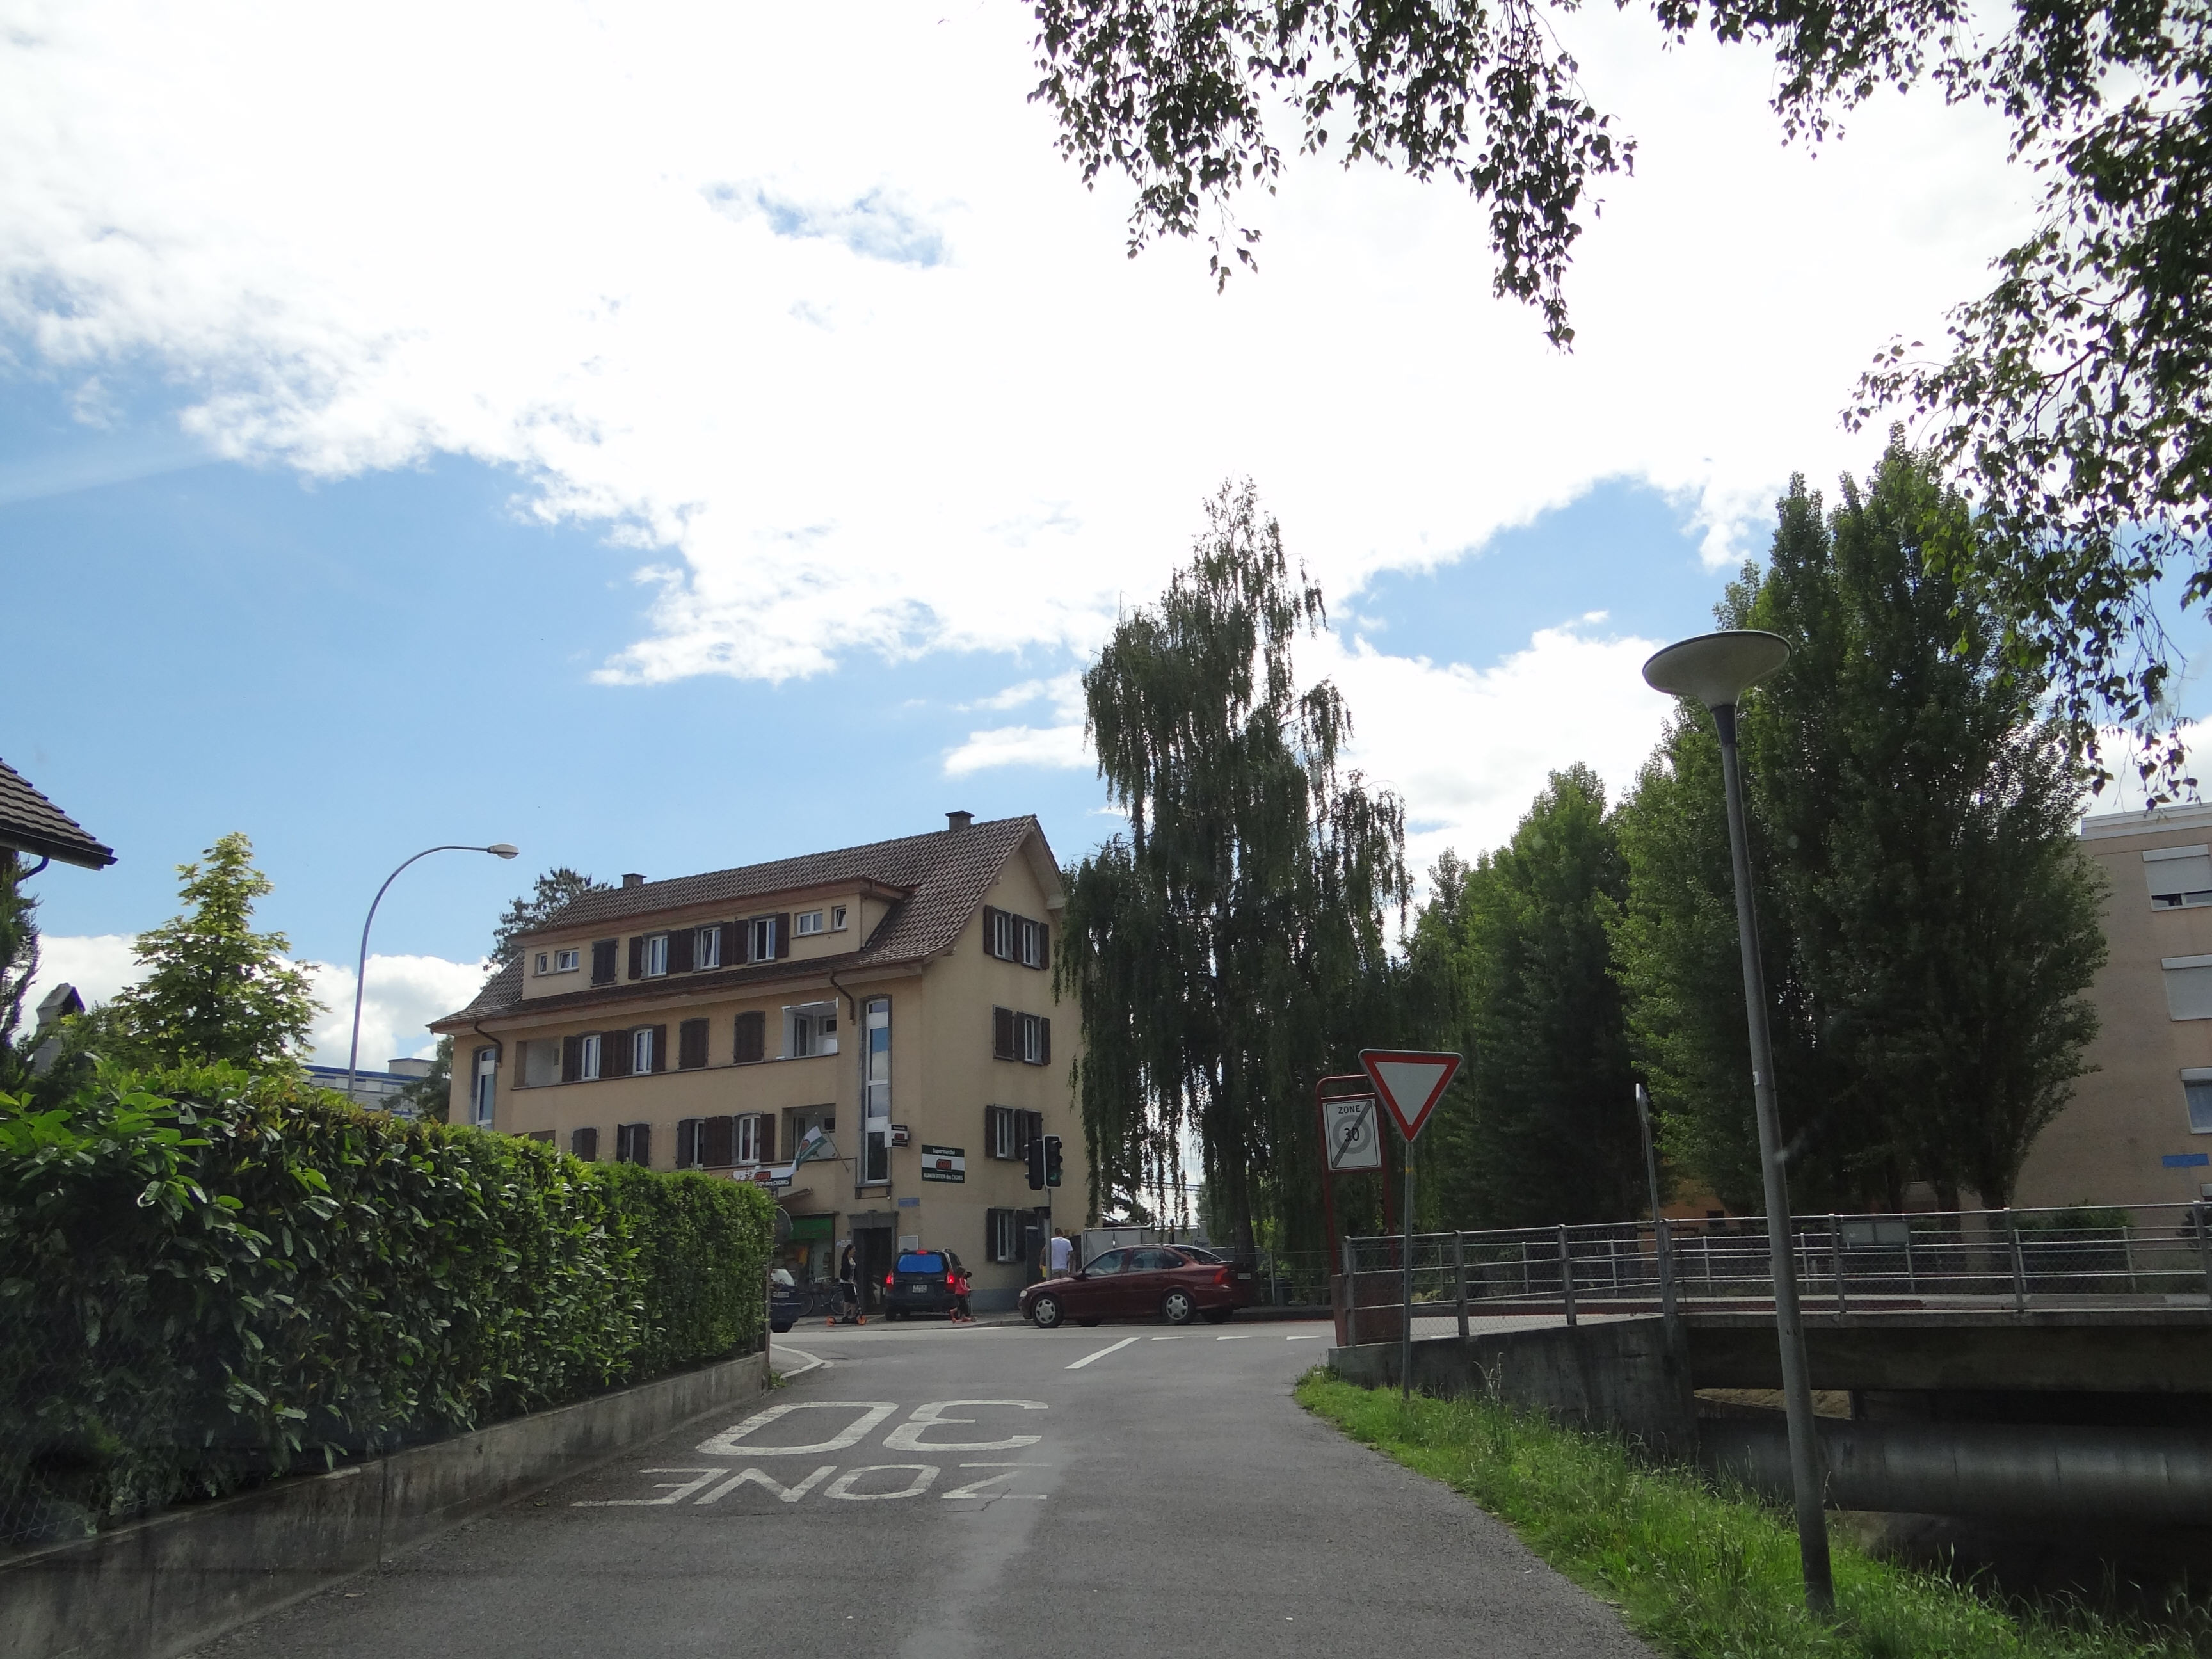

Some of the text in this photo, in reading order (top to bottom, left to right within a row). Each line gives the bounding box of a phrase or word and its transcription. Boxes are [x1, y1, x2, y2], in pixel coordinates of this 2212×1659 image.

[1338, 1105, 1361, 1114] ZONE
[1344, 1128, 1359, 1141] 30
[696, 1399, 1049, 1455] 30
[569, 1462, 1053, 1507] ZONE
